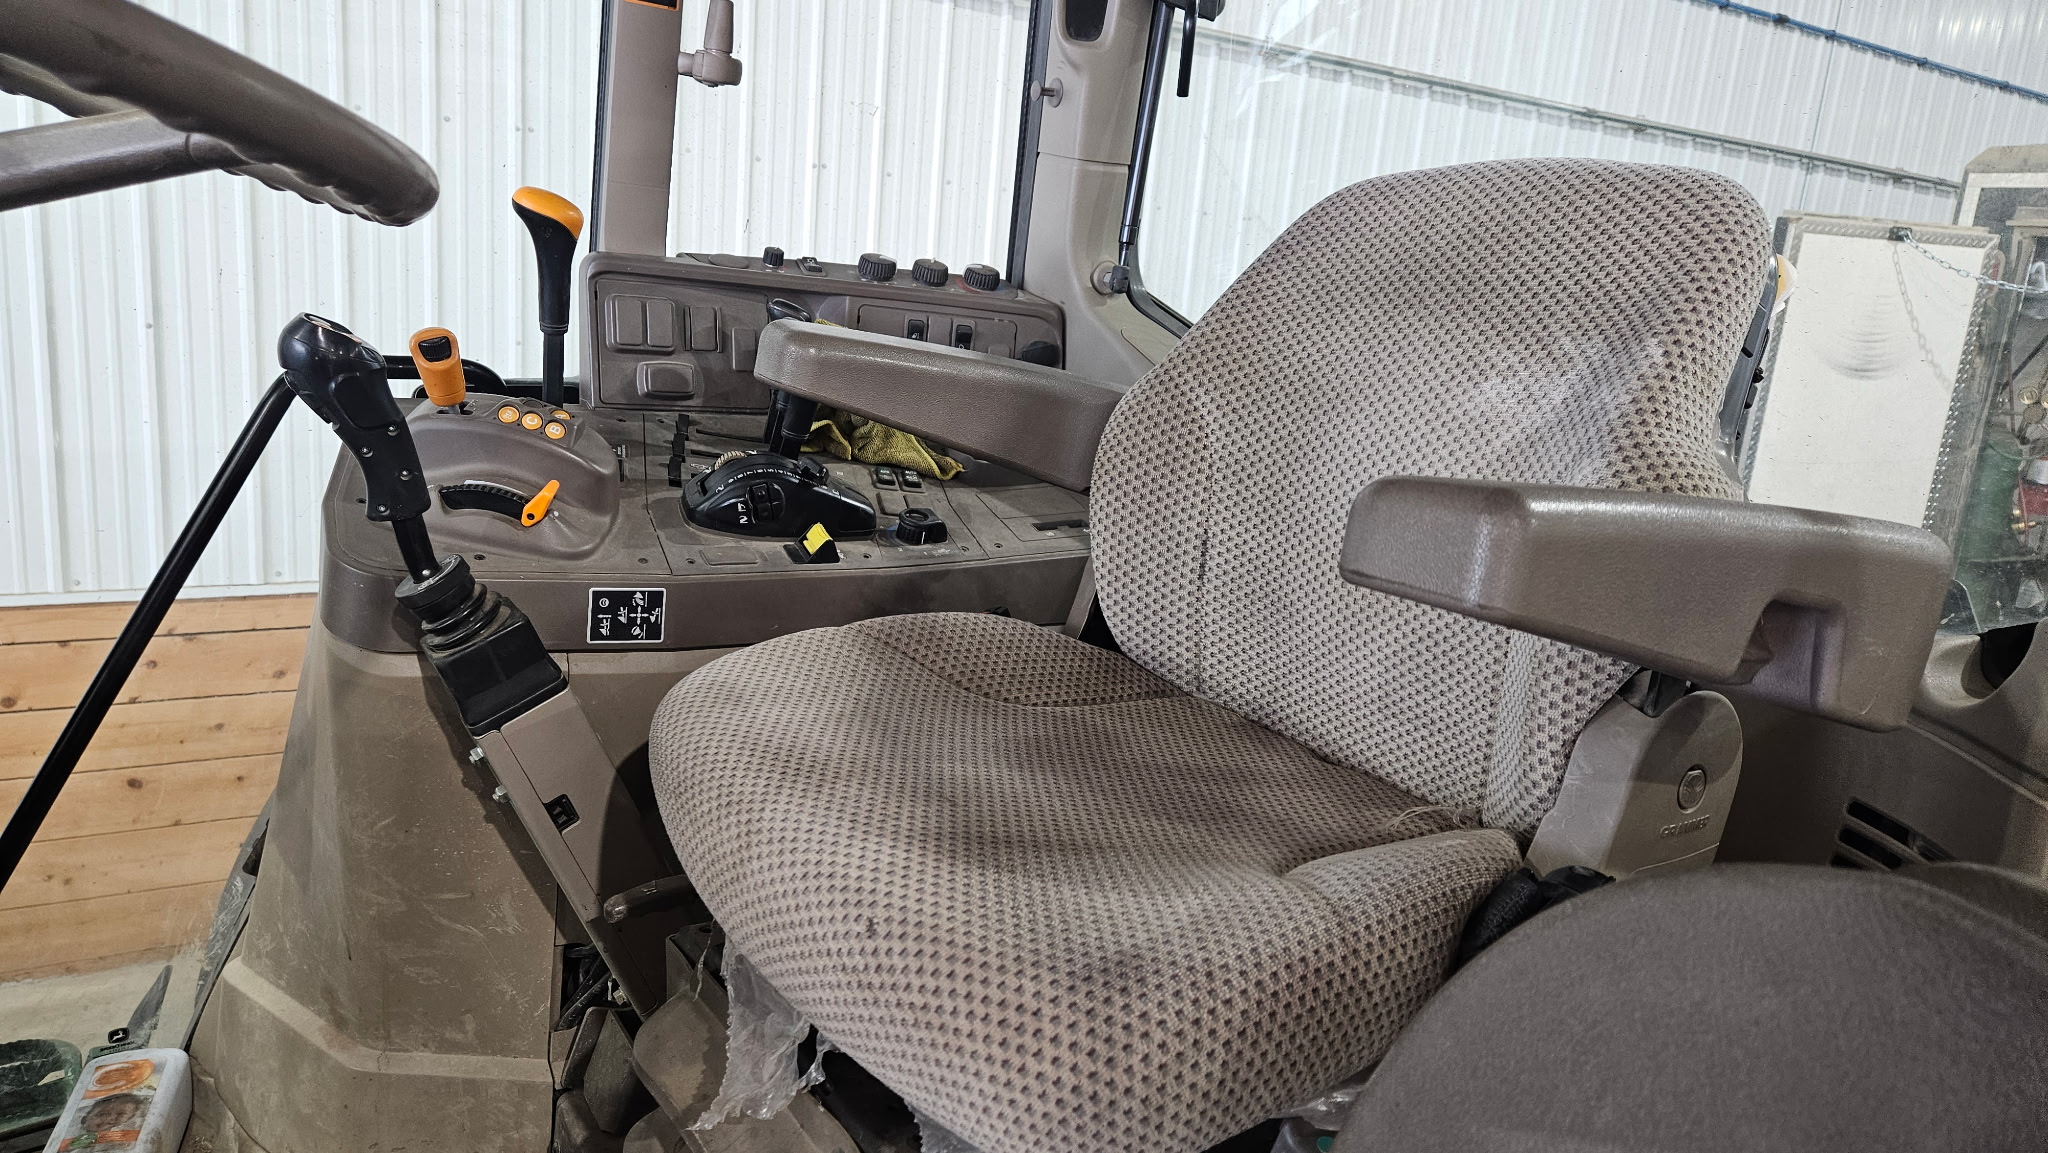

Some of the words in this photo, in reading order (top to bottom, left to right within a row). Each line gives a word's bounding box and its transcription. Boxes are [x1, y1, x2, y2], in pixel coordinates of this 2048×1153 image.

[526, 416, 538, 425] C
[549, 425, 561, 434] B
[1659, 814, 1710, 837] GRAMMER
